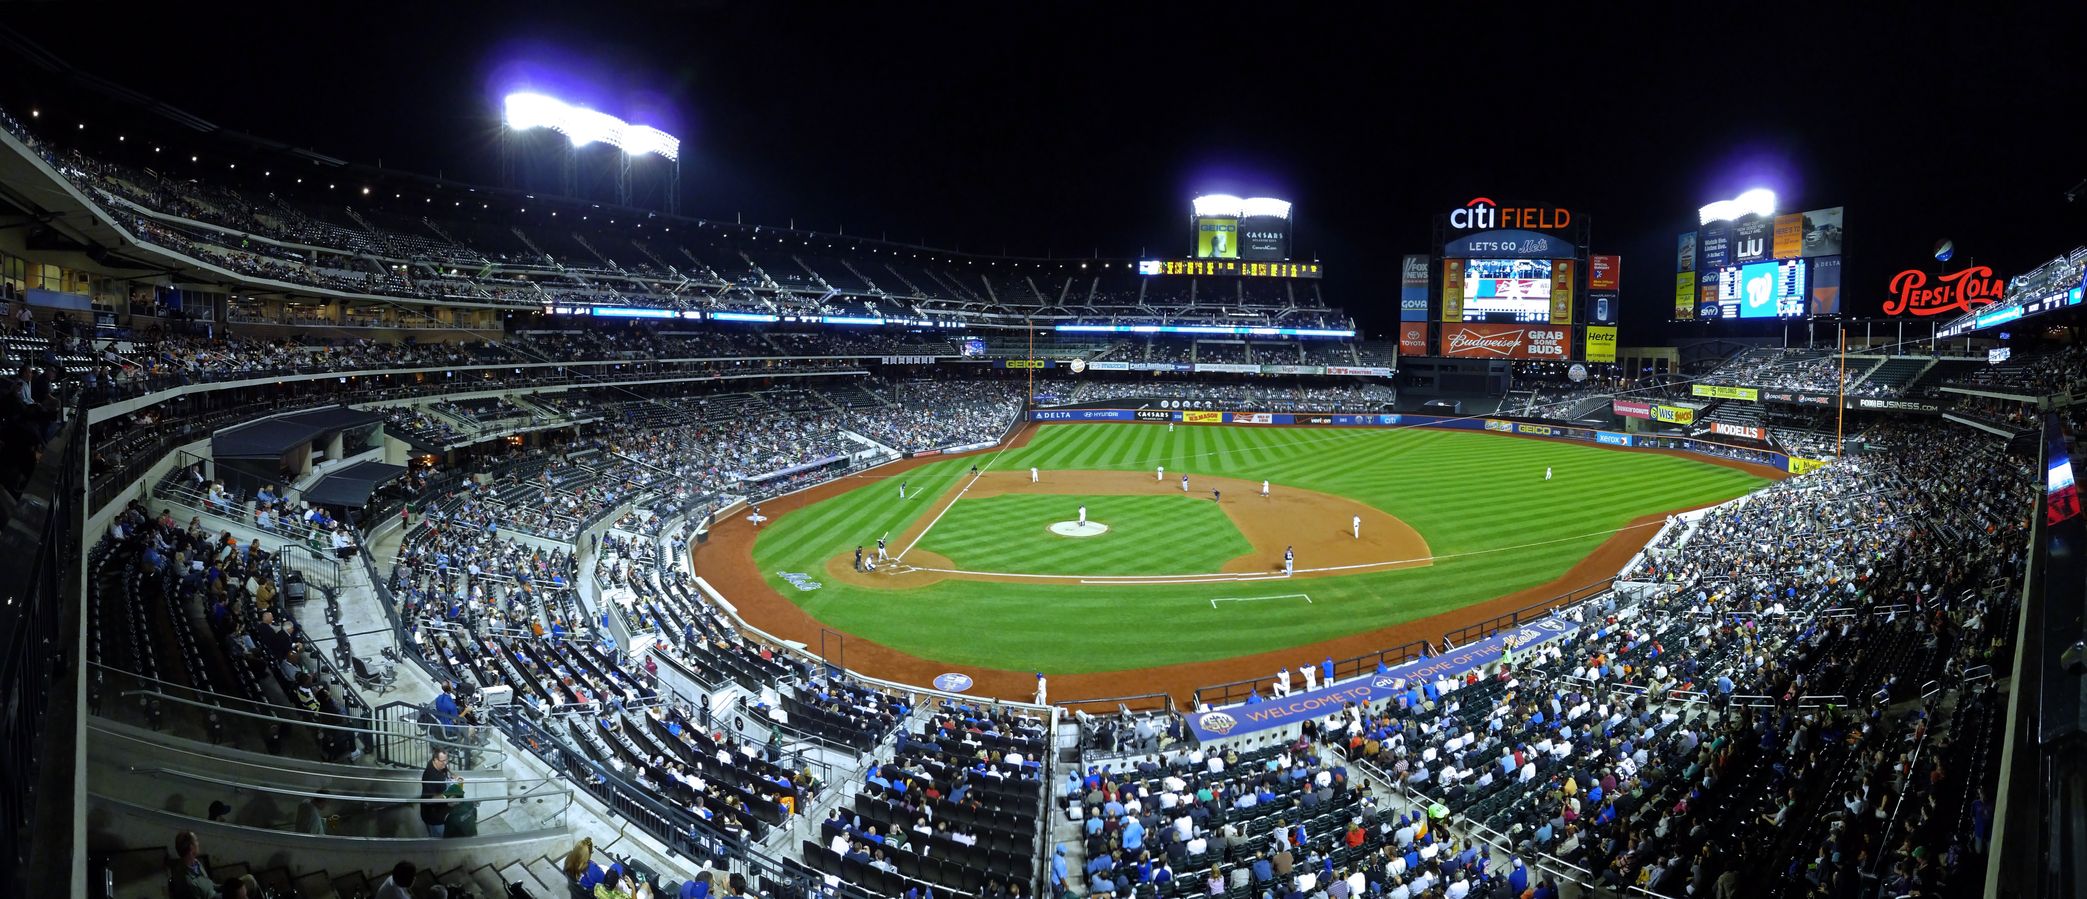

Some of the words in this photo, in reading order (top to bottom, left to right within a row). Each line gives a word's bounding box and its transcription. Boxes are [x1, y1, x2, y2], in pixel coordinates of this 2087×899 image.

[1450, 203, 1495, 229] citi
[1502, 208, 1571, 229] FIELD
[1200, 224, 1235, 232] GEICO
[1469, 242, 1498, 251] LET'S
[1501, 242, 1516, 251] GO
[1518, 239, 1548, 253] Mets
[1738, 238, 1763, 257] LIU
[1401, 300, 1427, 308] GOYA
[1701, 307, 1715, 316] SNY
[1448, 334, 1522, 347] Budweiser
[1528, 331, 1563, 340] GRAB
[1588, 332, 1614, 341] Hertz
[1528, 345, 1562, 354] BUDS
[1005, 360, 1045, 369] GEICO
[1660, 408, 1674, 419] WISE
[1384, 416, 1396, 424] citi
[1519, 425, 1551, 435] GEICO
[1717, 423, 1758, 438] MODELL'S
[1503, 629, 1541, 648] Mets
[1405, 662, 1454, 681] HOME
[1453, 654, 1473, 665] OF
[1471, 644, 1501, 660] THE
[1375, 677, 1393, 687] citi
[1247, 692, 1345, 722] WELCOME
[1342, 686, 1372, 699] TO
